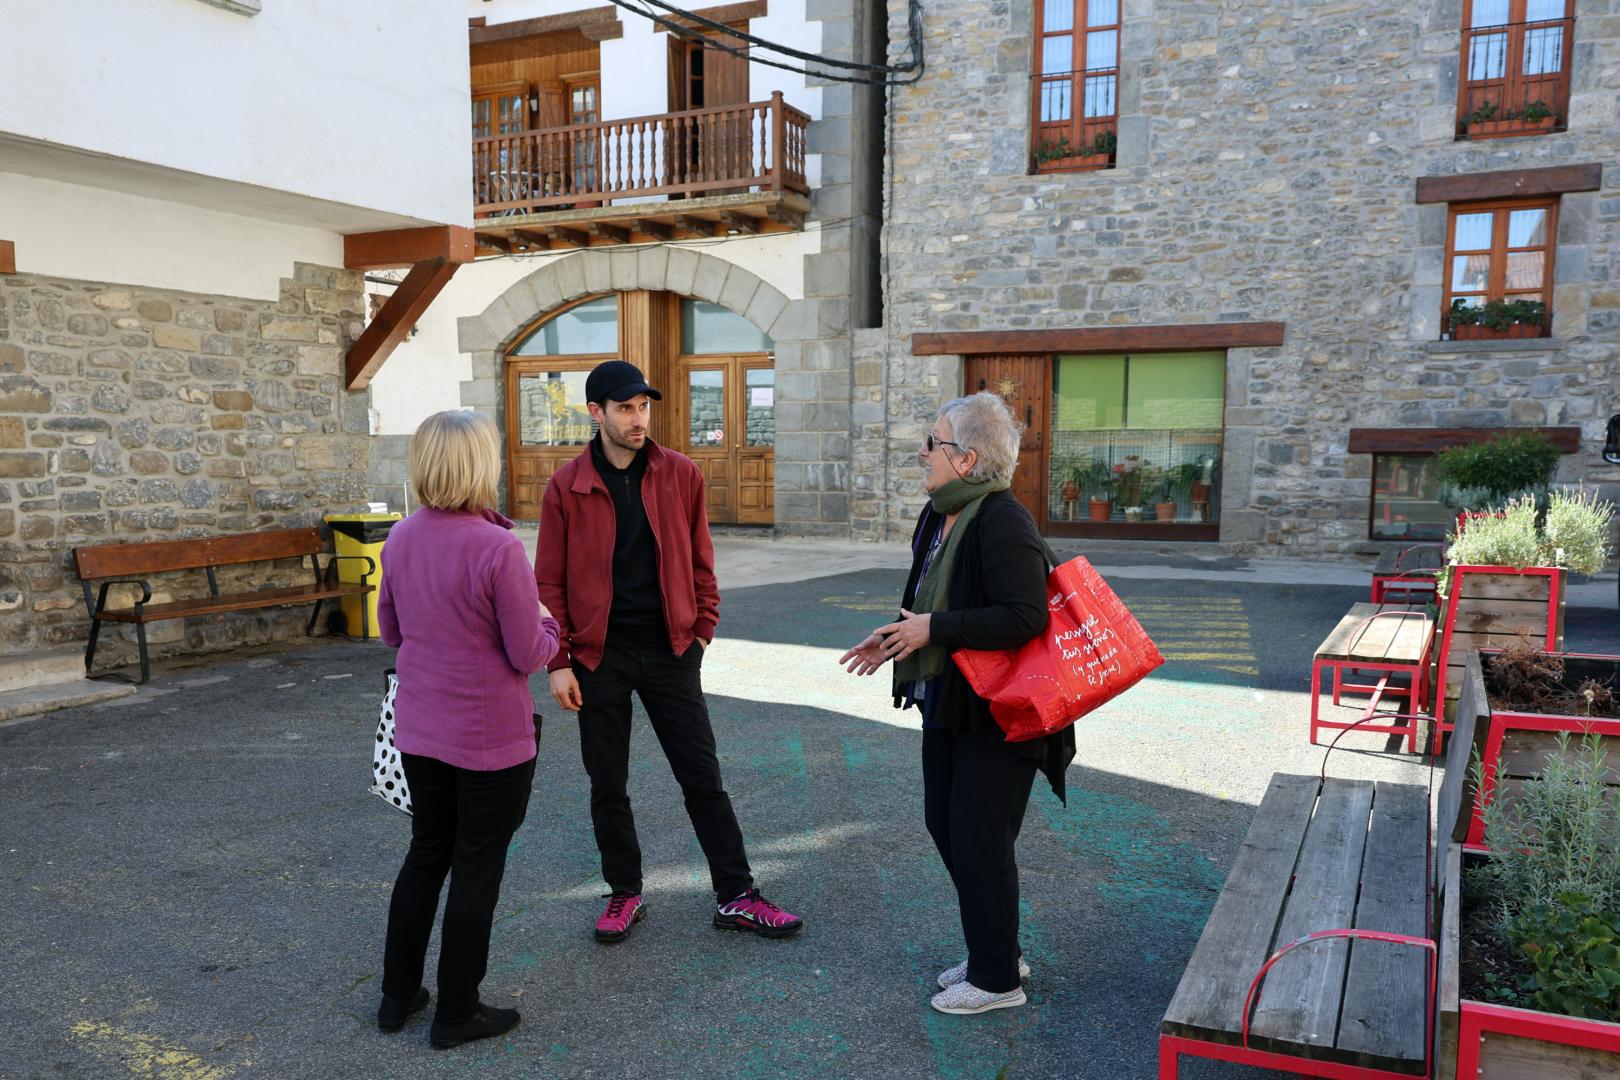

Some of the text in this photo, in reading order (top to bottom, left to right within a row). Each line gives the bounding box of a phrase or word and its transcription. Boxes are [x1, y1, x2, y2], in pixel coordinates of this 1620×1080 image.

[1062, 647, 1082, 660] tus
[1087, 658, 1101, 675] que
[1100, 647, 1118, 662] nada
[1087, 675, 1097, 686] te
